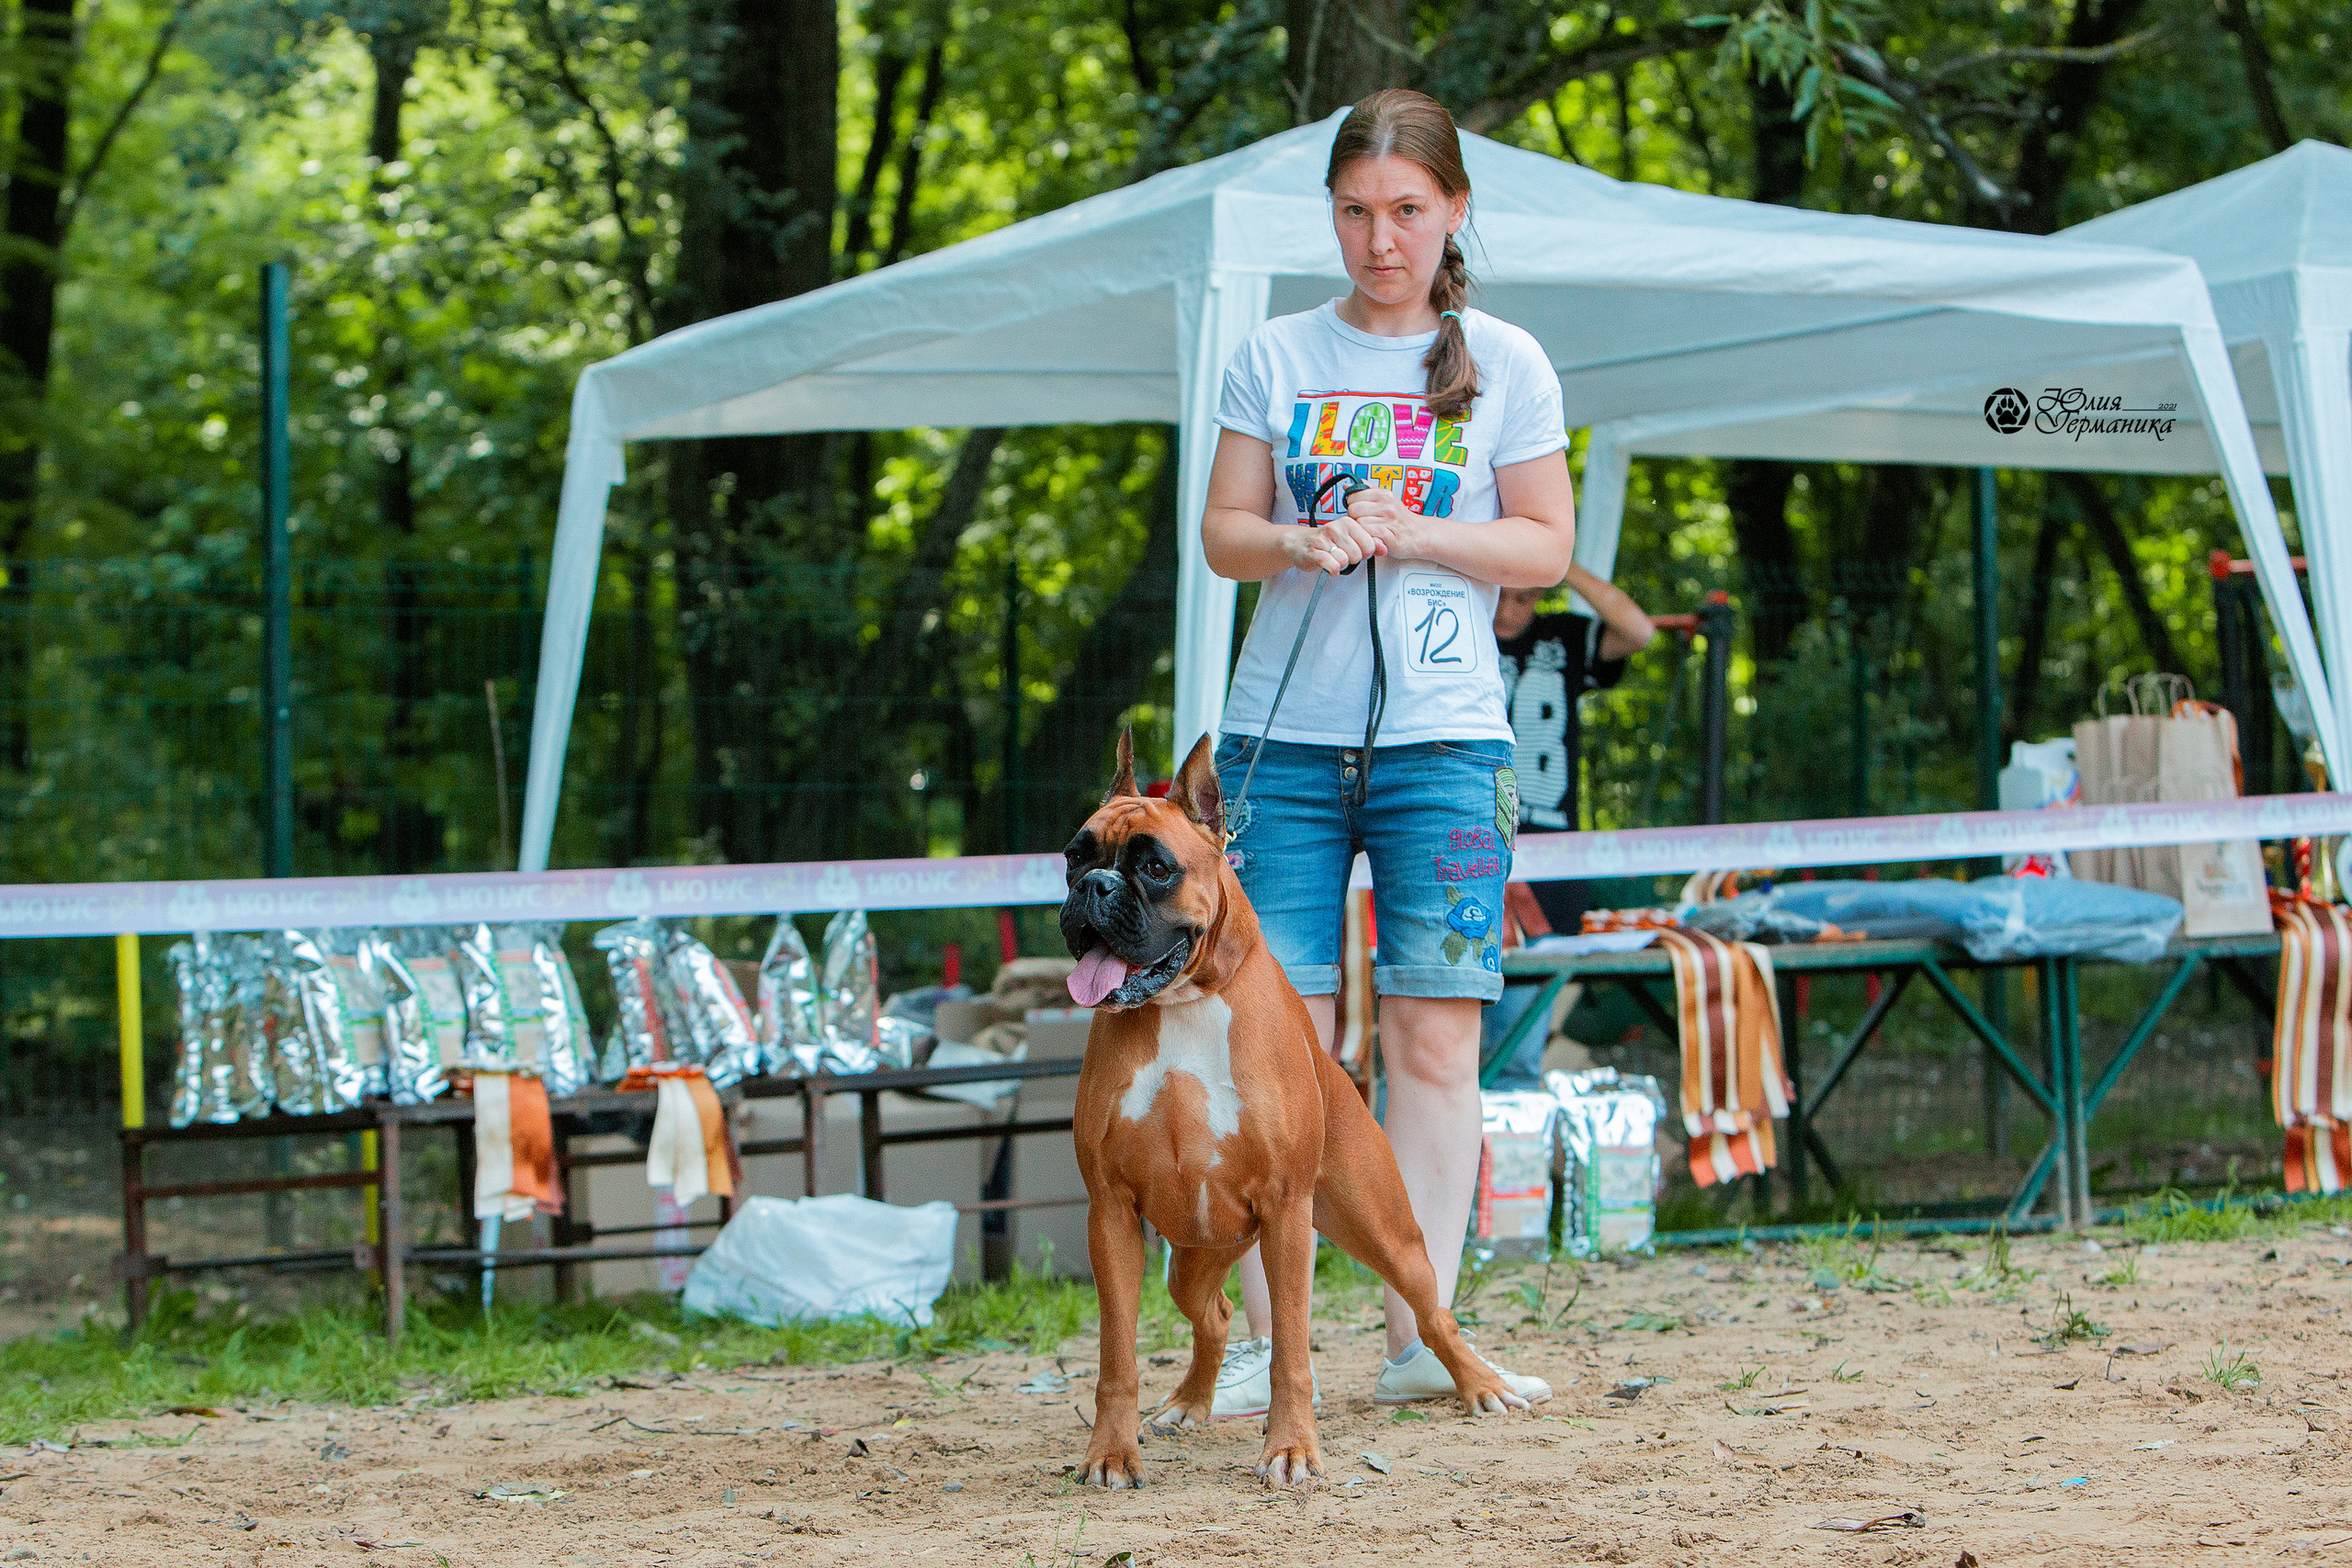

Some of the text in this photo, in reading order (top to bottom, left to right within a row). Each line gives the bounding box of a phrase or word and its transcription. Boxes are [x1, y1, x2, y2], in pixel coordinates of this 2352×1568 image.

[1286, 401, 1474, 467] I LOVE
[1414, 607, 1463, 665] 12
